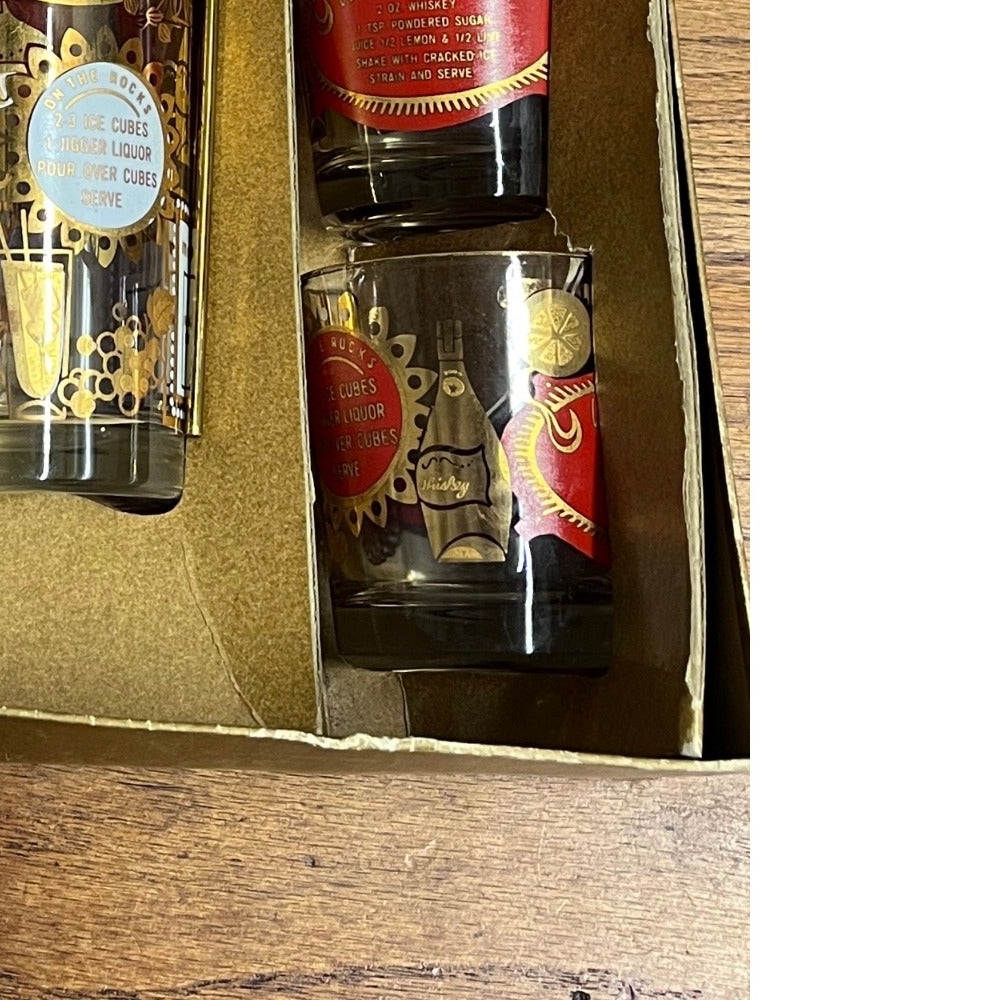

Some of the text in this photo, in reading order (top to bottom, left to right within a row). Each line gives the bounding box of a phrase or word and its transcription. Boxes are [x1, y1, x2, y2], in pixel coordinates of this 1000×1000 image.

[408, 0, 455, 12] WHISKEY
[392, 16, 449, 29] POWDERED
[401, 34, 436, 46] LEMON
[442, 34, 448, 44] &
[456, 32, 471, 42] 1/2
[356, 57, 386, 69] SHAKE
[392, 54, 417, 64] WITH
[424, 51, 474, 63] CRACKED
[370, 68, 472, 84] STRAIN AND SERVE
[44, 69, 152, 114] ON THE ROCKS
[84, 114, 104, 131] ICE
[112, 118, 149, 138] CUBES
[60, 136, 106, 155] JIGGER
[112, 141, 151, 162] LIQUOR
[38, 161, 157, 188] POUR OVER CUBES
[82, 189, 122, 208] SERVE
[339, 378, 377, 399] CUBES
[345, 403, 385, 423] LIQUOR
[358, 428, 398, 447] CUBES
